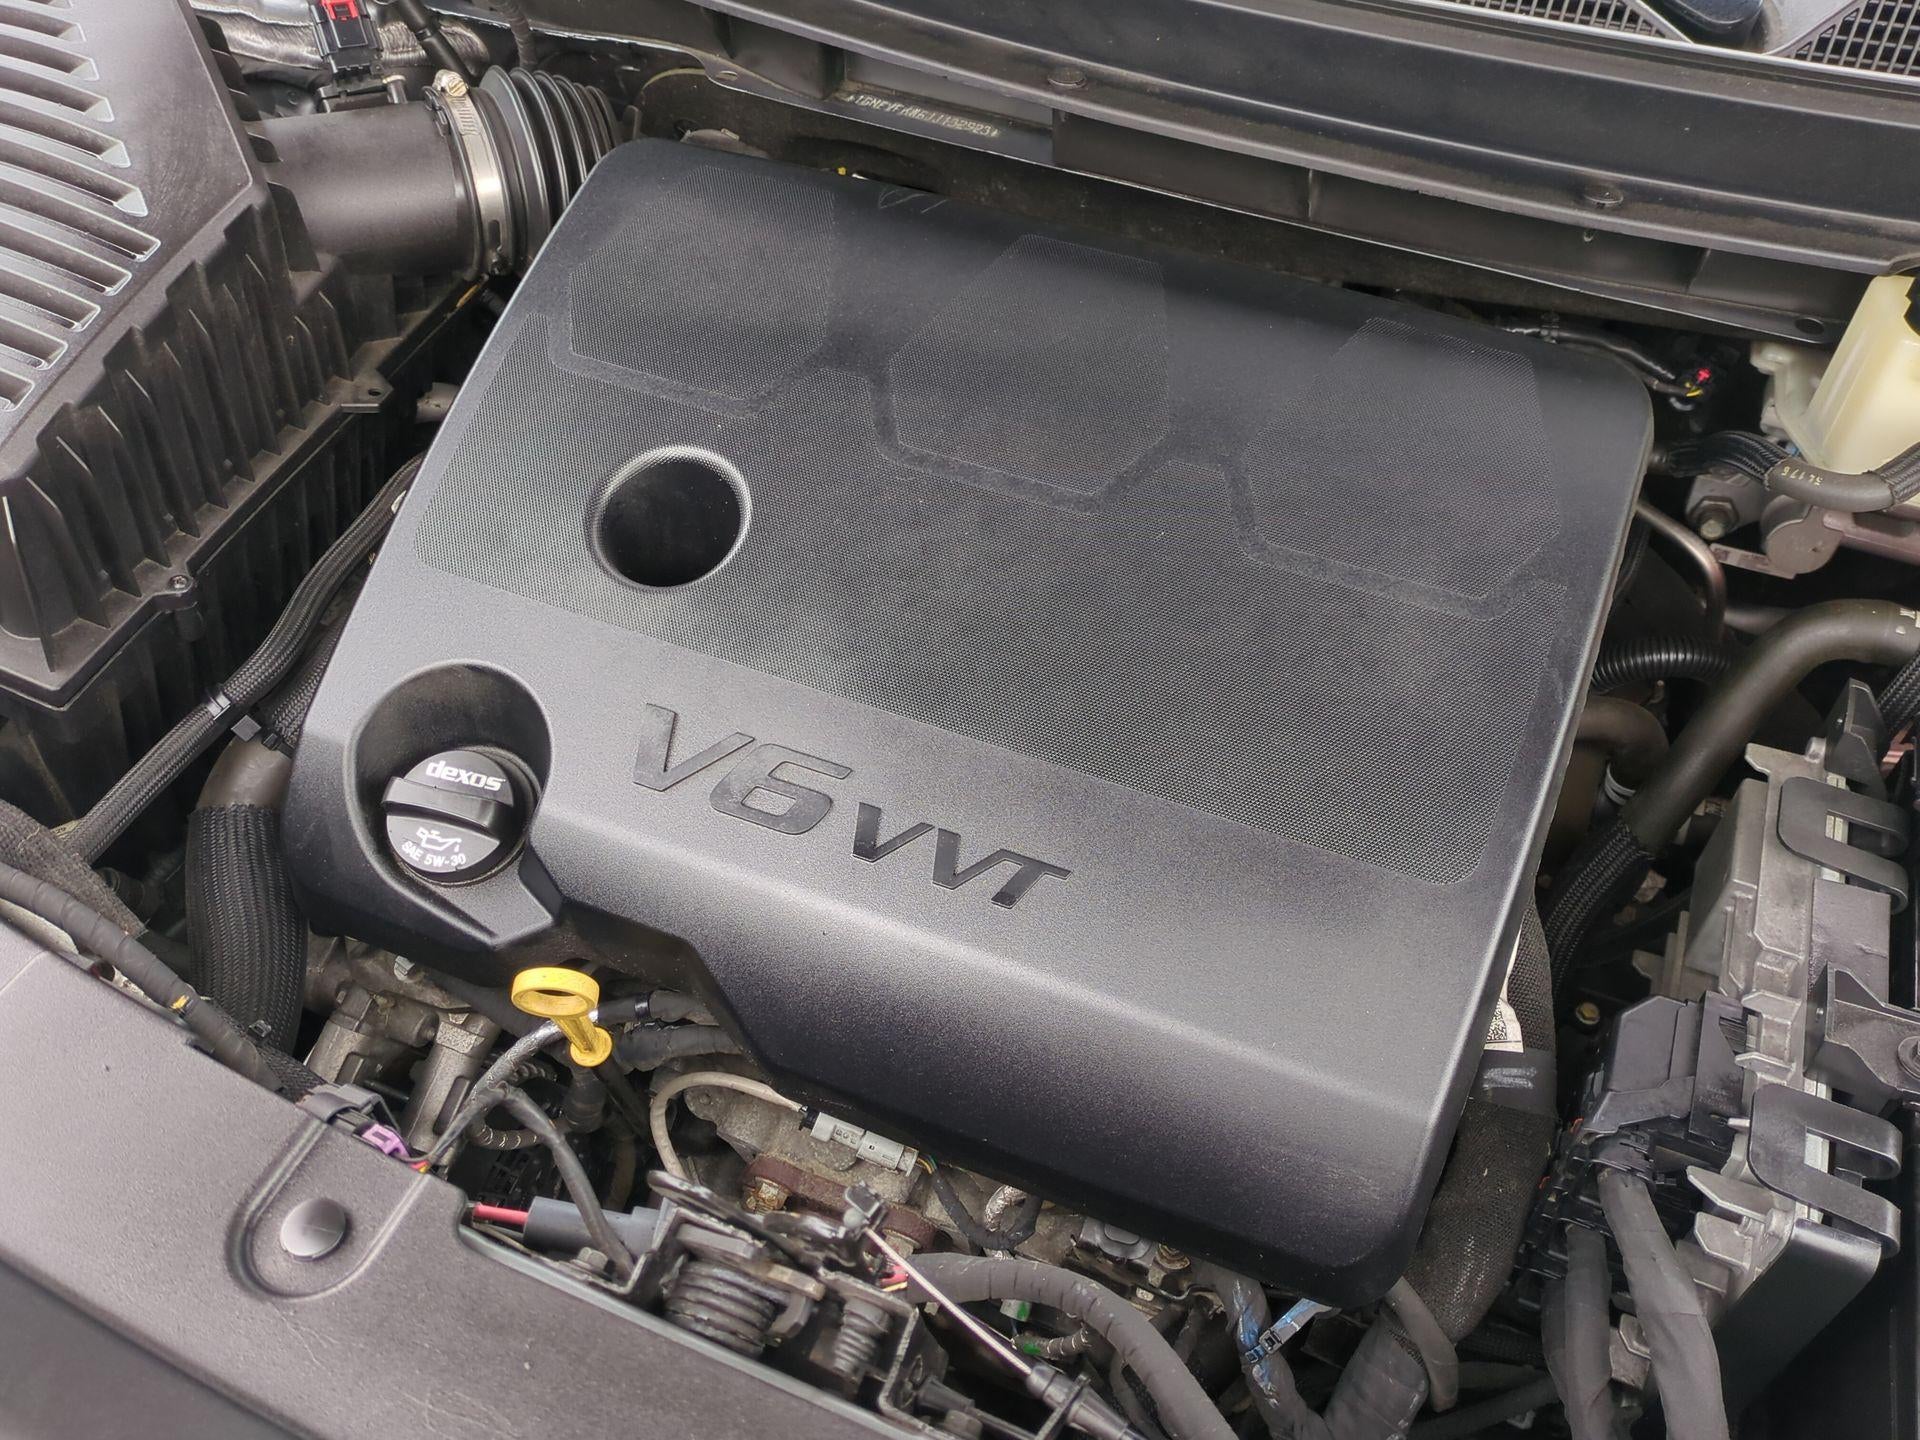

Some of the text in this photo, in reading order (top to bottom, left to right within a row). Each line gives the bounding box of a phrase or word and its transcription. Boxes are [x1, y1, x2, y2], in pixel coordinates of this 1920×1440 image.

[425, 760, 505, 791] dexos
[633, 702, 1072, 909] V6 VVT
[401, 840, 467, 868] SAE 5W-30
